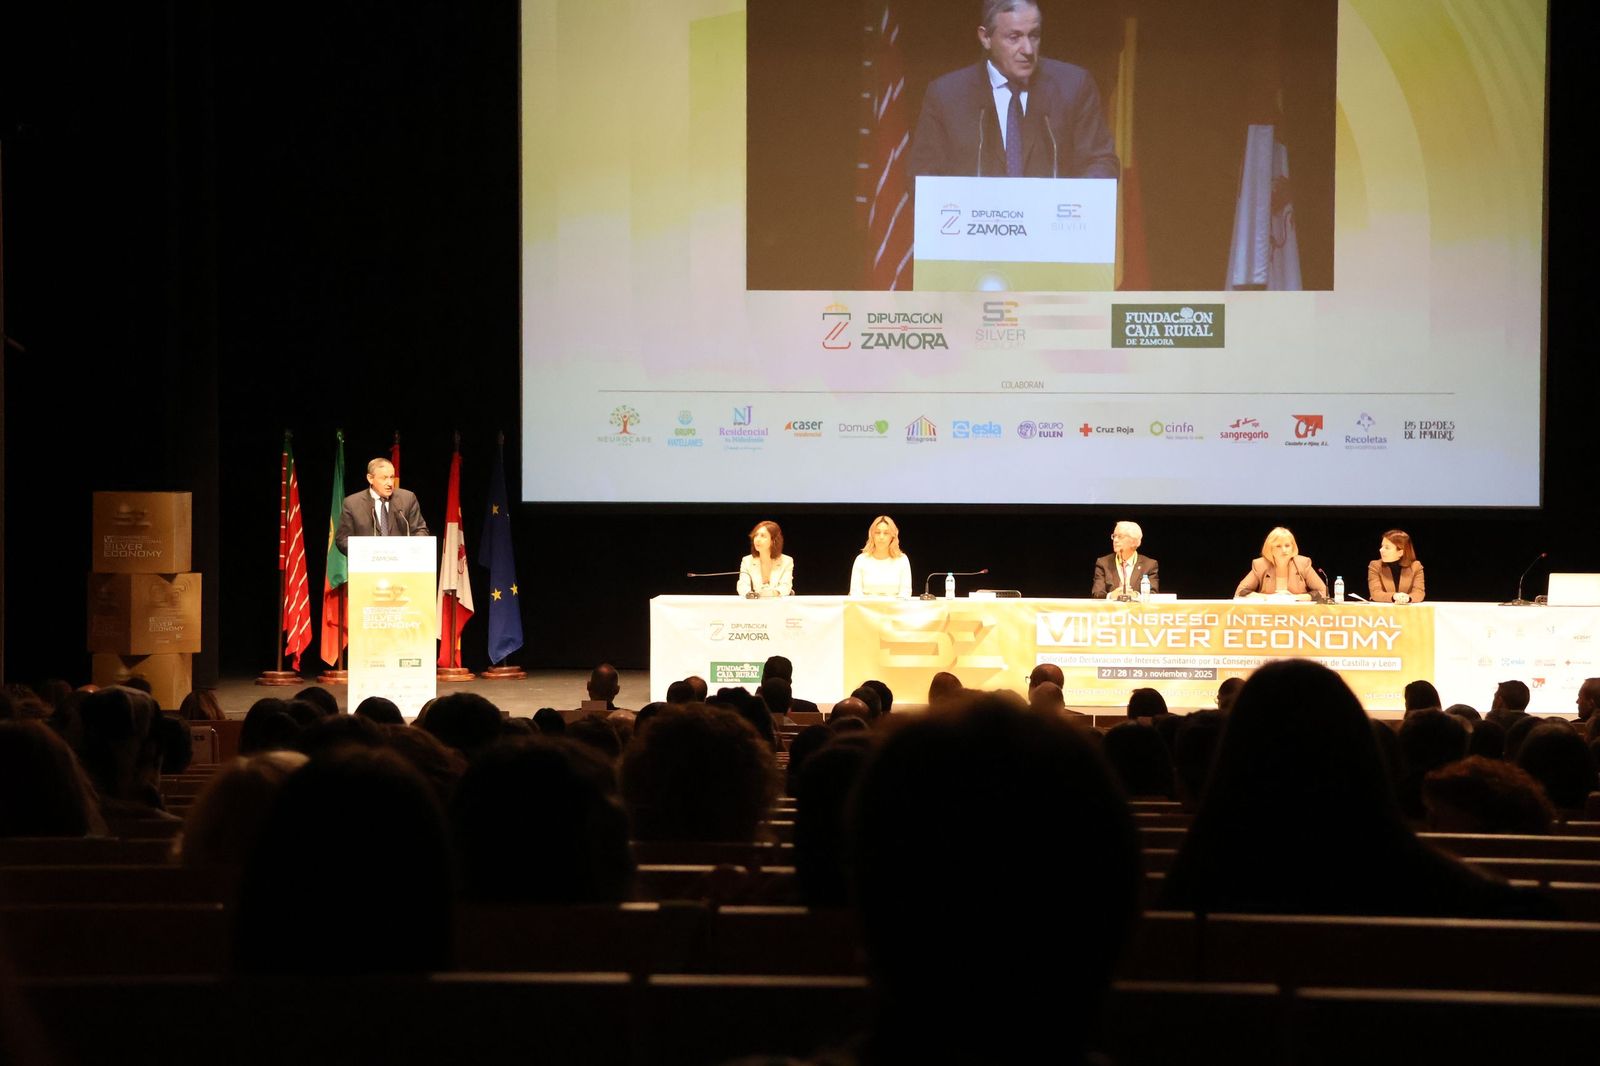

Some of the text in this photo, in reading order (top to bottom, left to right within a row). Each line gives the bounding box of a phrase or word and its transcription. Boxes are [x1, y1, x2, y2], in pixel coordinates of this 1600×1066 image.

[967, 223, 1027, 236] ZAMORA
[975, 328, 1026, 341] SILVER
[1125, 324, 1214, 337] CAJA RURAL
[861, 332, 949, 349] ZAMORA
[1000, 380, 1044, 389] COLABORAN
[792, 421, 823, 430] caser
[838, 423, 874, 432] Domus
[972, 421, 1002, 434] esla
[1038, 422, 1064, 430] GRUPO
[1165, 421, 1194, 433] cinfa
[719, 427, 768, 436] Residencial
[1116, 426, 1134, 435] Roja
[1220, 430, 1269, 441] sangregorio
[1345, 435, 1387, 443] Recoletas
[103, 550, 163, 558] ECONOMY
[1096, 613, 1402, 628] CONGRESO INTERNACIONAL
[1040, 615, 1088, 643] VII
[728, 632, 770, 641] ZAMORA
[1096, 628, 1402, 650] SILVER ECONOMY
[1198, 658, 1210, 666] por
[1213, 657, 1220, 665] la
[1330, 659, 1339, 667] de
[1341, 659, 1369, 667] Castilla
[1101, 669, 1213, 678] 27 28 29 noviembre 2025
